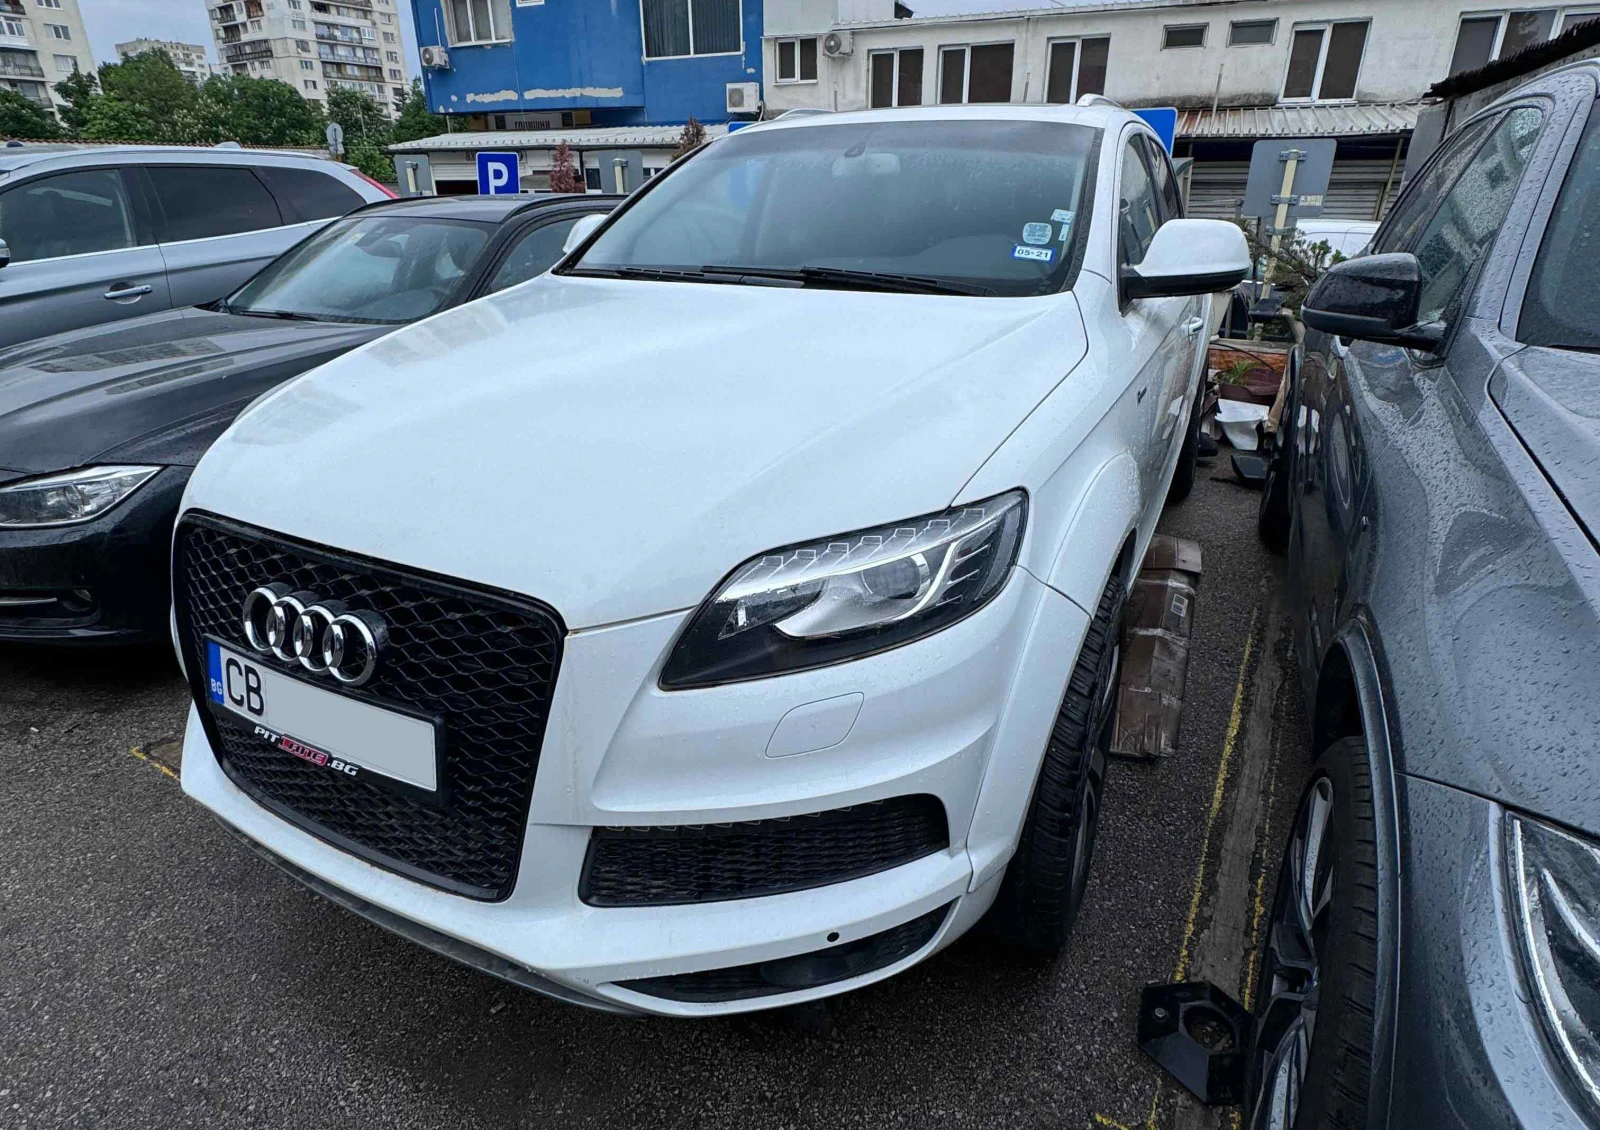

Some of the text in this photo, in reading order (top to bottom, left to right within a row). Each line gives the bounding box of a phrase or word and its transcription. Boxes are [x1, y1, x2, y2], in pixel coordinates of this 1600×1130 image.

[487, 161, 508, 195] P
[211, 678, 223, 695] BG
[226, 657, 265, 716] CB
